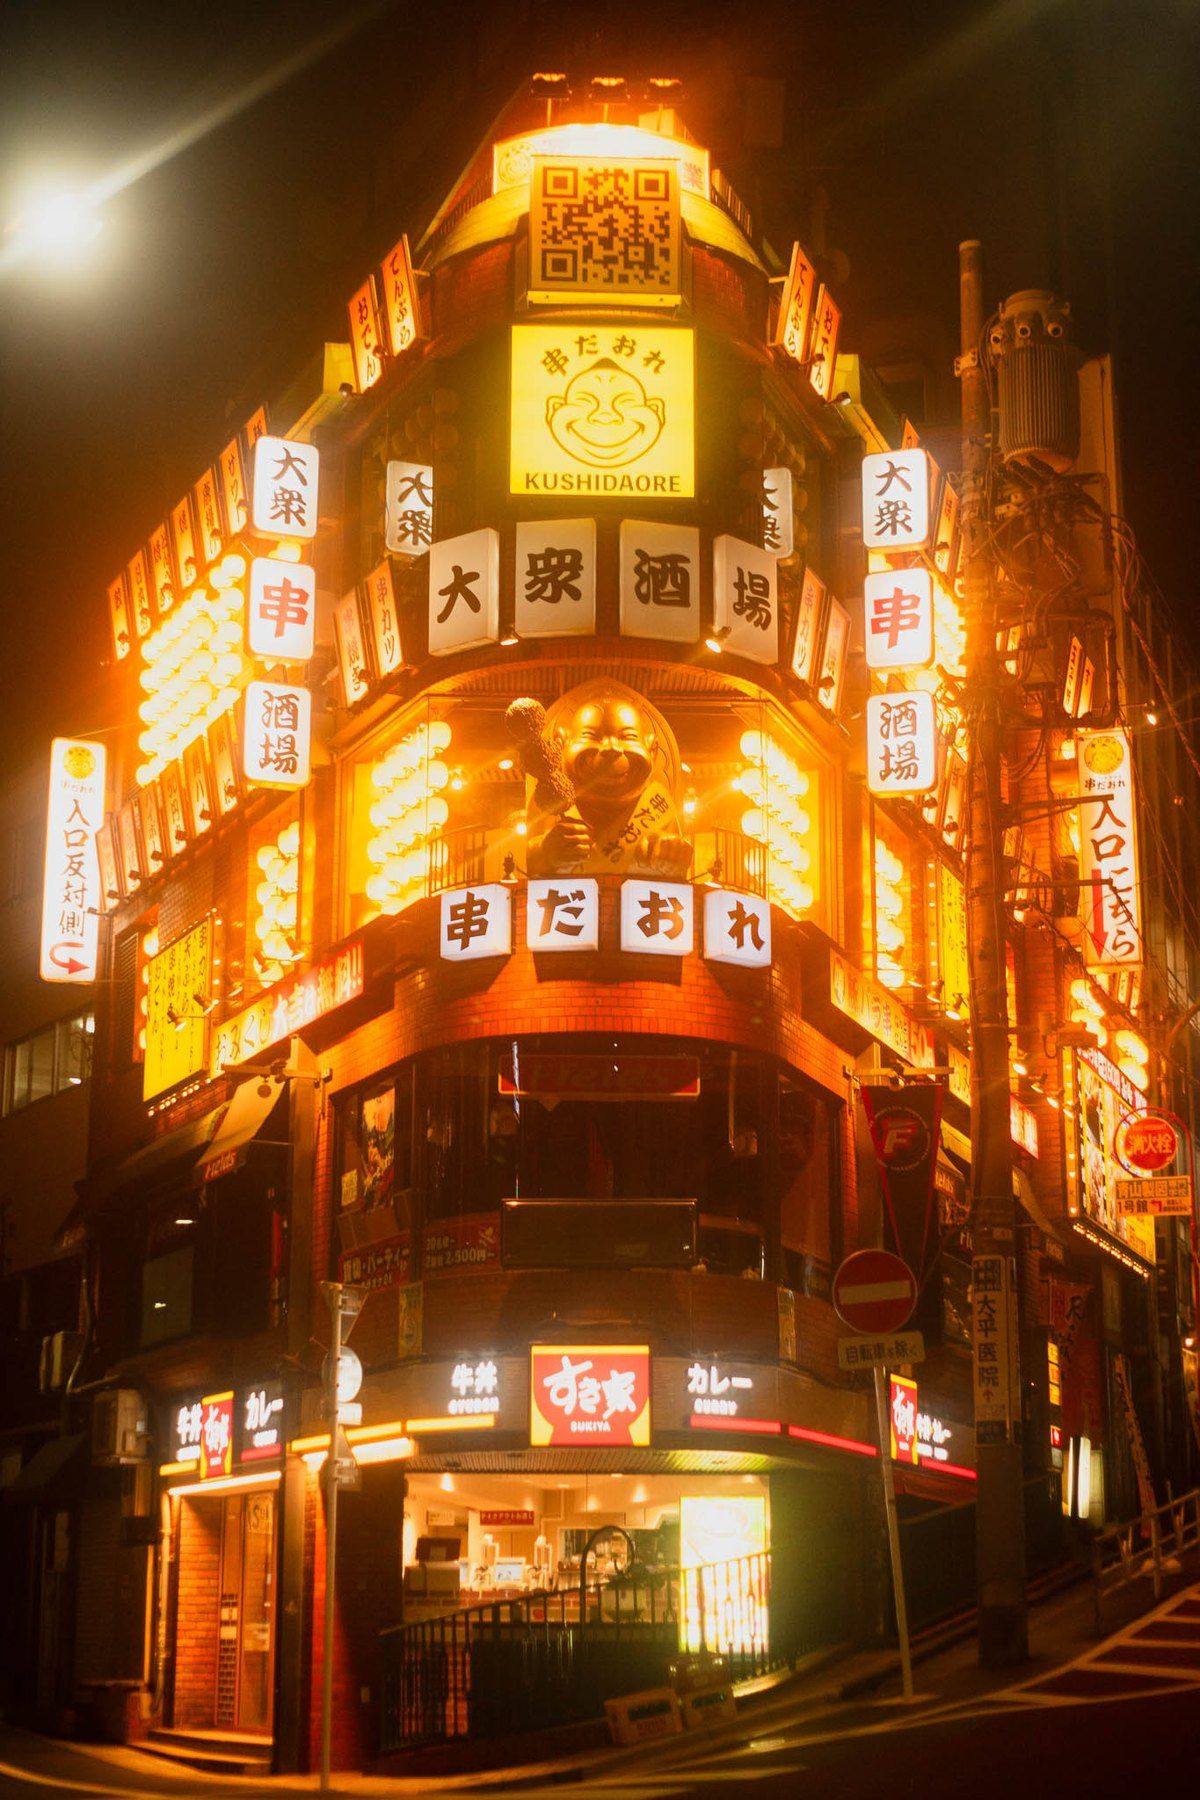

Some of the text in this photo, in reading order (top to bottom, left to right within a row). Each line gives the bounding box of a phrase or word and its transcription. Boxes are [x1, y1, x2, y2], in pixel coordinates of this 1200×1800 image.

[541, 334, 667, 376] 串だおれ
[270, 447, 308, 527] 大衆
[525, 473, 682, 493] KUSHIDAORE
[874, 460, 912, 537] 大衆
[259, 577, 310, 638] 串
[437, 547, 772, 631] 大衆酒場
[871, 587, 922, 650] 串
[259, 690, 301, 775] 酒場
[879, 700, 921, 782] 酒場
[603, 793, 669, 864] 串だおれ
[59, 799, 90, 937] 入口反対側
[447, 889, 766, 952] 串だおれ
[1128, 1133, 1173, 1154] 消火栓
[977, 1296, 999, 1387] 大平医院
[451, 1361, 497, 1395] 牛丼
[543, 1355, 637, 1420] すき家
[688, 1363, 752, 1394] カレー
[245, 1391, 283, 1430] カレー
[571, 1420, 611, 1432] SUKIYA
